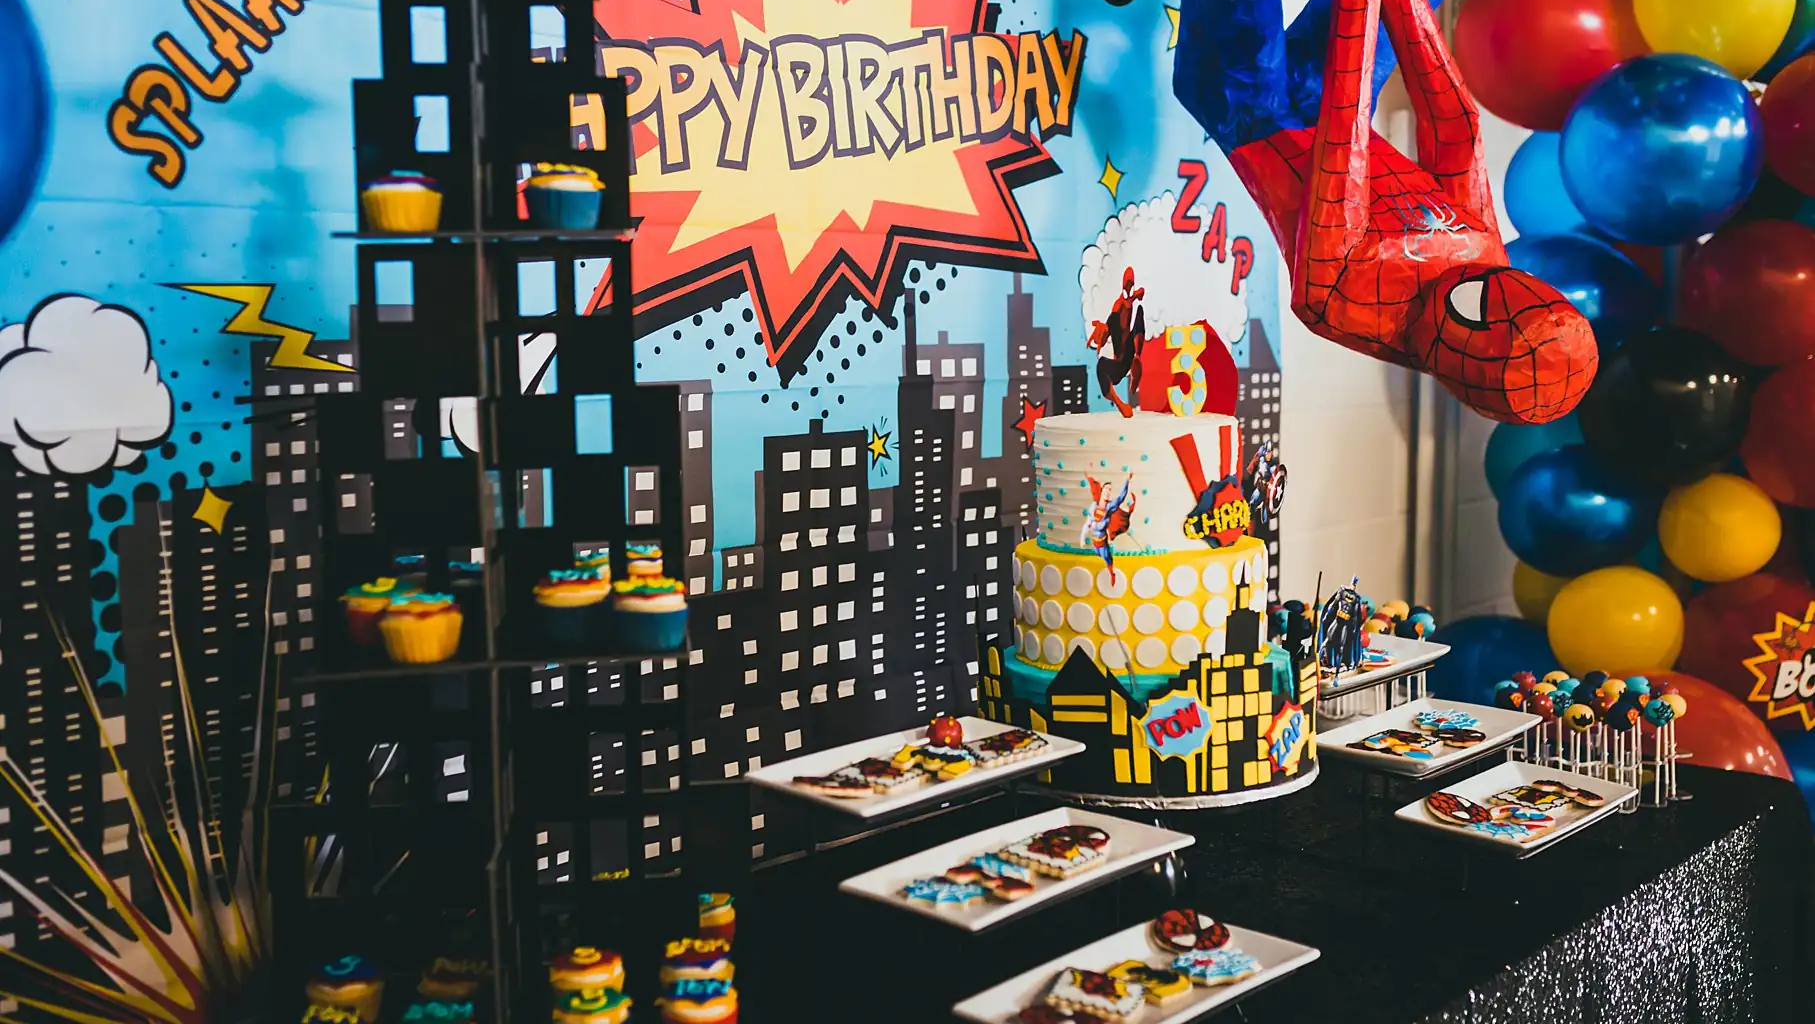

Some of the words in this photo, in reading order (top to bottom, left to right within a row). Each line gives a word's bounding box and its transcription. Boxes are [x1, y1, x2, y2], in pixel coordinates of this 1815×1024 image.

[768, 28, 1088, 171] BIRTHDAY
[1171, 159, 1254, 296] ZAP
[1165, 325, 1208, 417] 3
[1147, 702, 1202, 746] POW
[1269, 712, 1302, 767] ZAP
